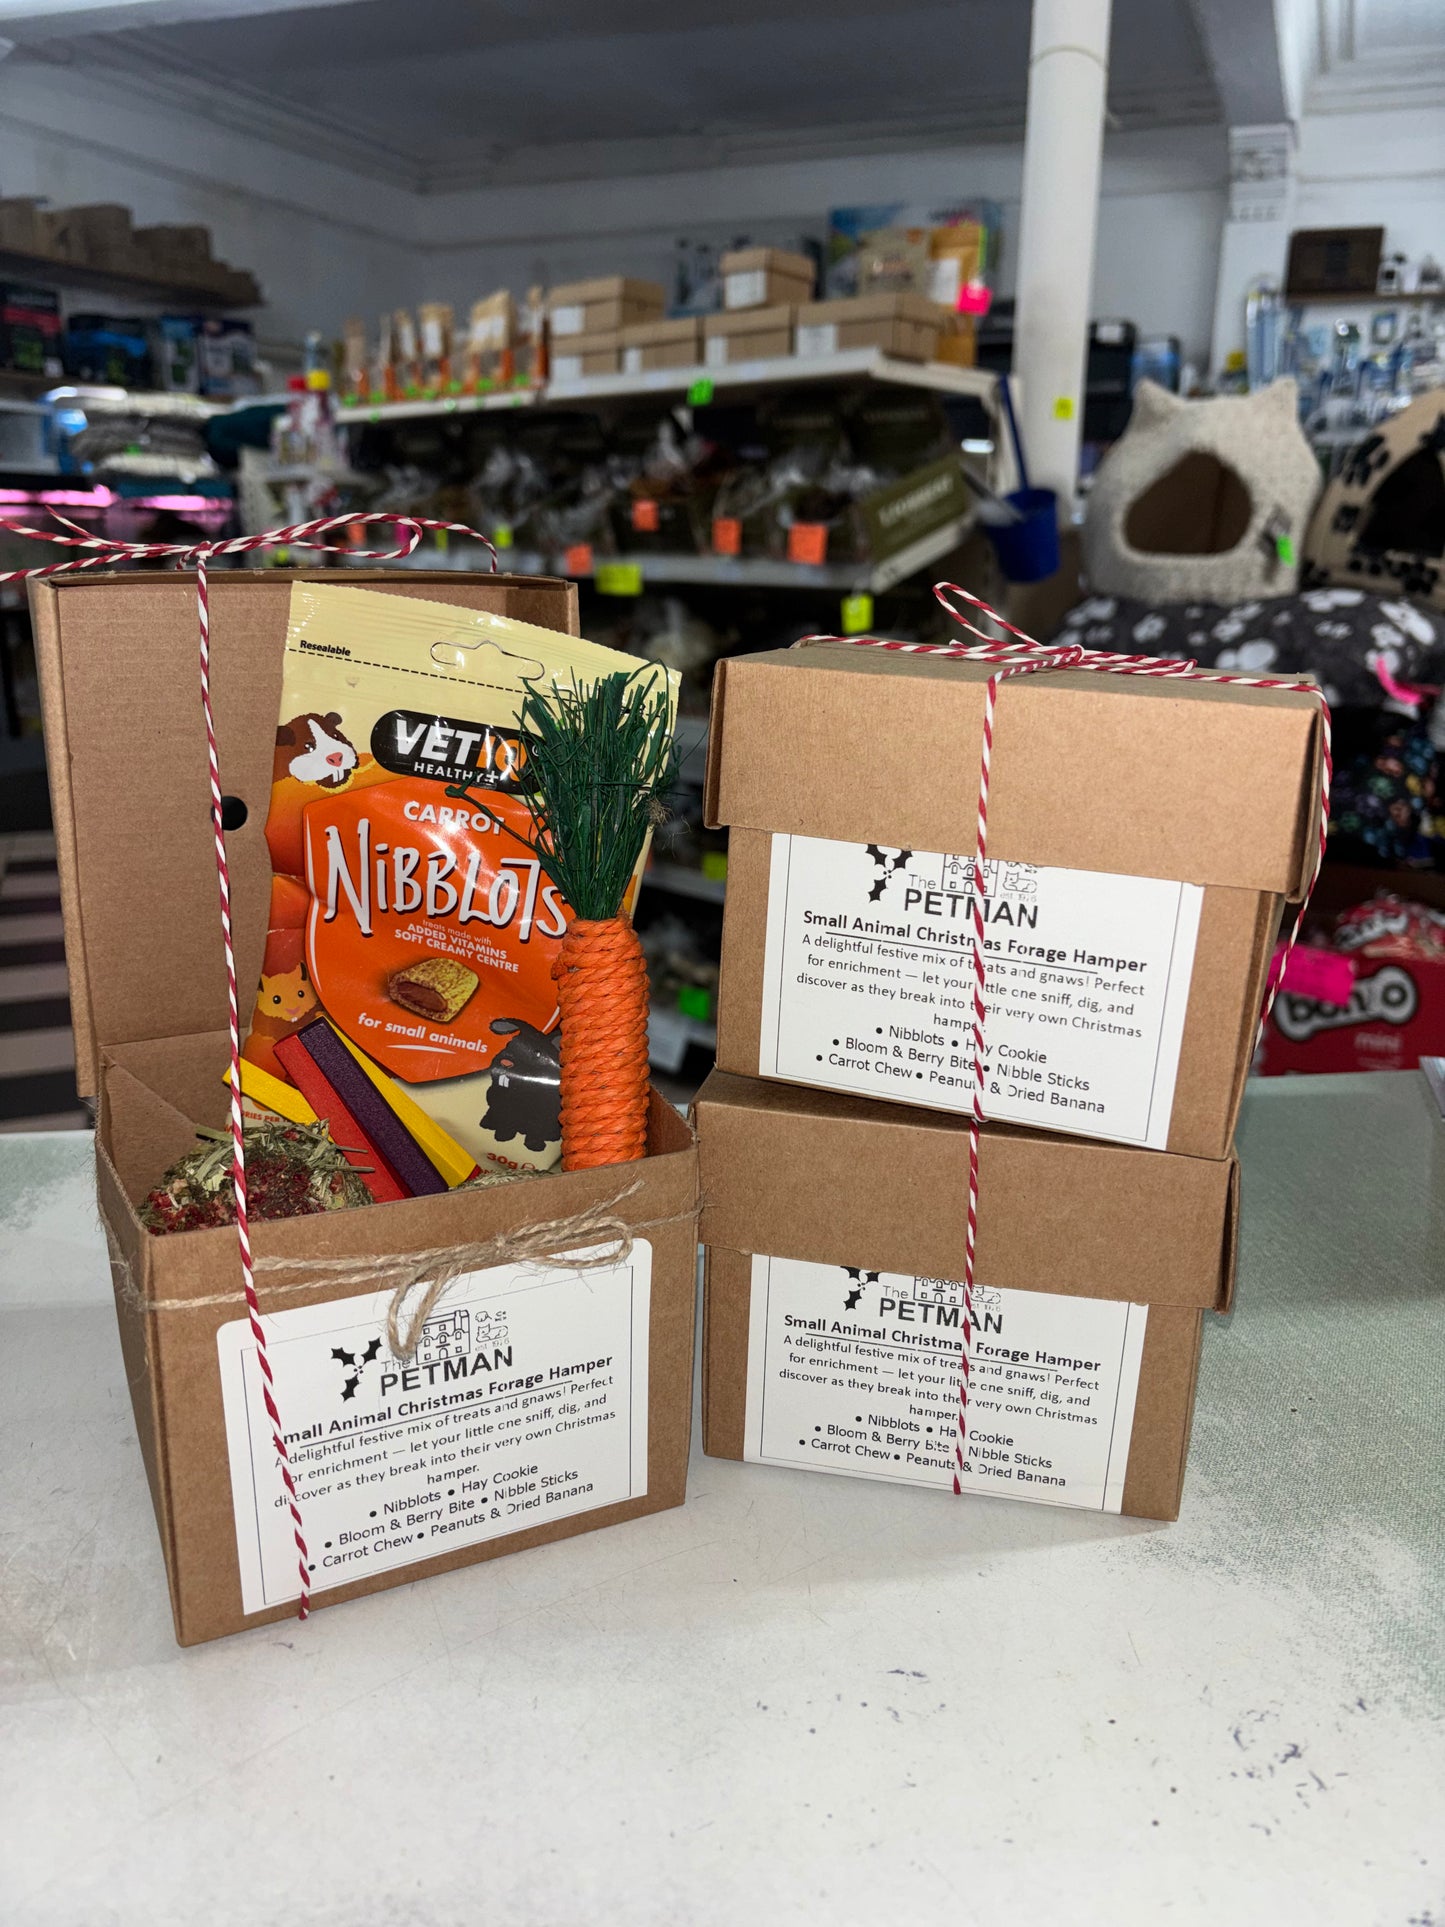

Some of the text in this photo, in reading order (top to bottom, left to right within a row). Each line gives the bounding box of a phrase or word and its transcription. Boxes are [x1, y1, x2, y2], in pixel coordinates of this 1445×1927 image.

[300, 640, 351, 656] Resealable
[403, 801, 505, 835] CARROT
[909, 874, 936, 889] The
[394, 929, 519, 973] SOFT CREAMY CENTRE
[407, 923, 507, 960] ADDED VITAMINS
[422, 919, 492, 946] treats made with
[804, 910, 1147, 972] Small Animal Forage Hamper
[802, 934, 810, 945] A
[814, 936, 873, 954] delightful
[878, 944, 918, 961] festive
[923, 953, 946, 965] mix
[950, 957, 964, 967] of
[1010, 968, 1036, 979] and
[1095, 978, 1144, 995] Perfect
[808, 954, 824, 966] for
[828, 961, 901, 978] enrichment
[923, 971, 939, 984] let
[943, 978, 973, 989] your
[1041, 993, 1072, 1008] sniff,
[1078, 997, 1102, 1013] dig,
[1107, 1004, 1134, 1015] and
[797, 972, 1141, 1037] discover as they break into very own Christmas
[358, 1012, 488, 1053] for small animals
[889, 1025, 1047, 1063] Nibblots Cookie
[829, 1054, 870, 1071] Carrot
[875, 1061, 912, 1078] Chew
[990, 1082, 1001, 1095] &
[1050, 1092, 1104, 1113] Banana
[846, 1037, 1089, 1091] Bloom & Berry Bite Nibble Sticks
[486, 1152, 518, 1170] 30g
[880, 1297, 1003, 1334] PETMAN
[883, 1285, 908, 1299] The
[381, 1359, 412, 1373] The
[784, 1315, 1101, 1371] Small Animal Forage Hamper
[784, 1335, 792, 1344] A
[795, 1337, 851, 1353] delightful
[855, 1345, 894, 1359] festive
[898, 1353, 919, 1364] mix
[923, 1356, 937, 1366] of
[979, 1366, 1002, 1375] and
[1055, 1375, 1099, 1390] Perfect
[329, 1356, 612, 1434] Animal Christmas Forage Hamper
[381, 1345, 512, 1396] PETMAN
[789, 1352, 1090, 1406] for enrichment let your sniff, dig, and
[287, 1438, 354, 1464] delightful
[359, 1430, 403, 1446] festive
[408, 1422, 431, 1435] mix
[435, 1415, 449, 1427] of
[453, 1408, 491, 1423] treats
[495, 1397, 518, 1413] and
[571, 1376, 613, 1394] Perfect
[779, 1368, 828, 1384] discover
[848, 1378, 874, 1393] they
[878, 1382, 911, 1397] break
[915, 1388, 938, 1400] into
[975, 1400, 1002, 1412] very
[1005, 1405, 1031, 1415] own
[1035, 1407, 1097, 1424] Christmas
[909, 1404, 960, 1421] hamper.
[308, 1450, 388, 1479] enrichment
[411, 1440, 428, 1452] let
[431, 1433, 461, 1450] your
[466, 1424, 494, 1438] little
[526, 1407, 554, 1423] sniff,
[558, 1403, 580, 1414] dig,
[584, 1393, 606, 1408] and
[337, 1412, 615, 1490] as they break into their very own Christmas
[827, 1424, 1052, 1468] Bloom & Berry Nibble Sticks
[868, 1414, 1014, 1446] Nibblots Cookie
[427, 1465, 479, 1485] hamper.
[811, 1438, 851, 1454] Carrot
[855, 1445, 890, 1460] Chew
[961, 1461, 972, 1472] &
[1017, 1469, 1065, 1486] Banana
[339, 1471, 578, 1545] Bloom & Berry Bite Nibble Sticks
[384, 1465, 538, 1515] Nibblots Hay Cookie
[323, 1546, 369, 1567] Carrot
[374, 1534, 413, 1552] Chew
[431, 1514, 485, 1536] Peanuts
[490, 1508, 501, 1519] &
[546, 1483, 593, 1503] Banana
